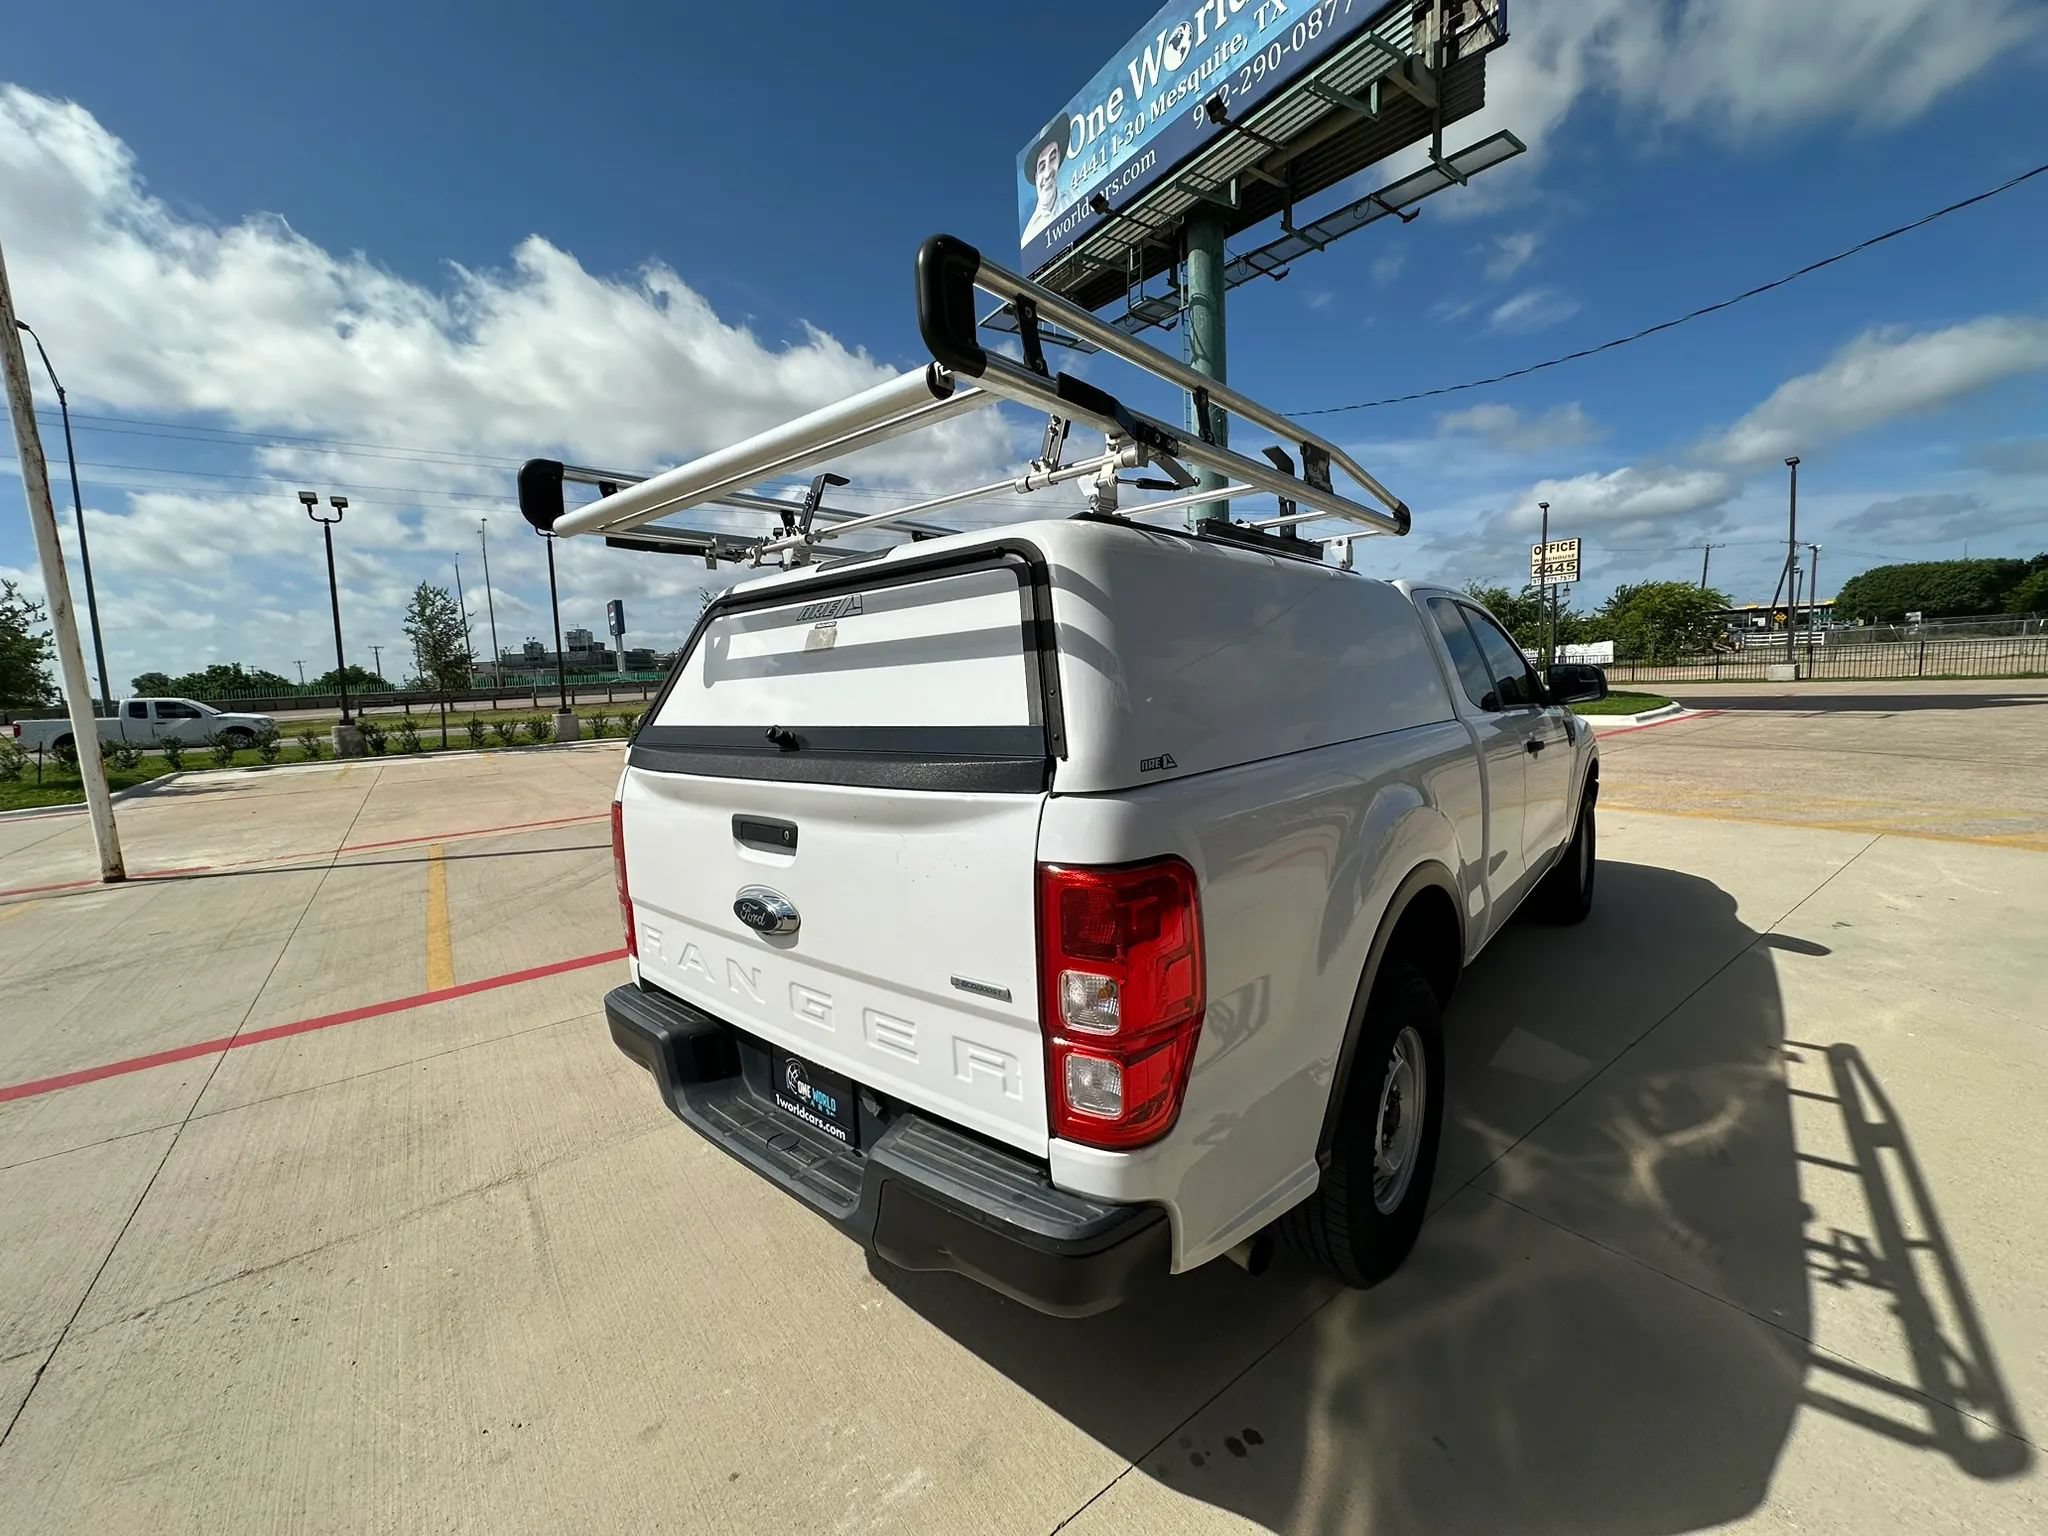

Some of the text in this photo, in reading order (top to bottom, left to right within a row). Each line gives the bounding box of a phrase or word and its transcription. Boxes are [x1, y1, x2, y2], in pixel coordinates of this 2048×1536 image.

[1066, 0, 1248, 160] One Worl
[1071, 0, 1288, 190] 4441 I-30 Mesquite, TX
[740, 902, 767, 927] Ford
[639, 922, 1025, 1103] RANGER
[775, 1093, 846, 1141] 1worldcars.com
[797, 1080, 837, 1112] ONE WORLD
